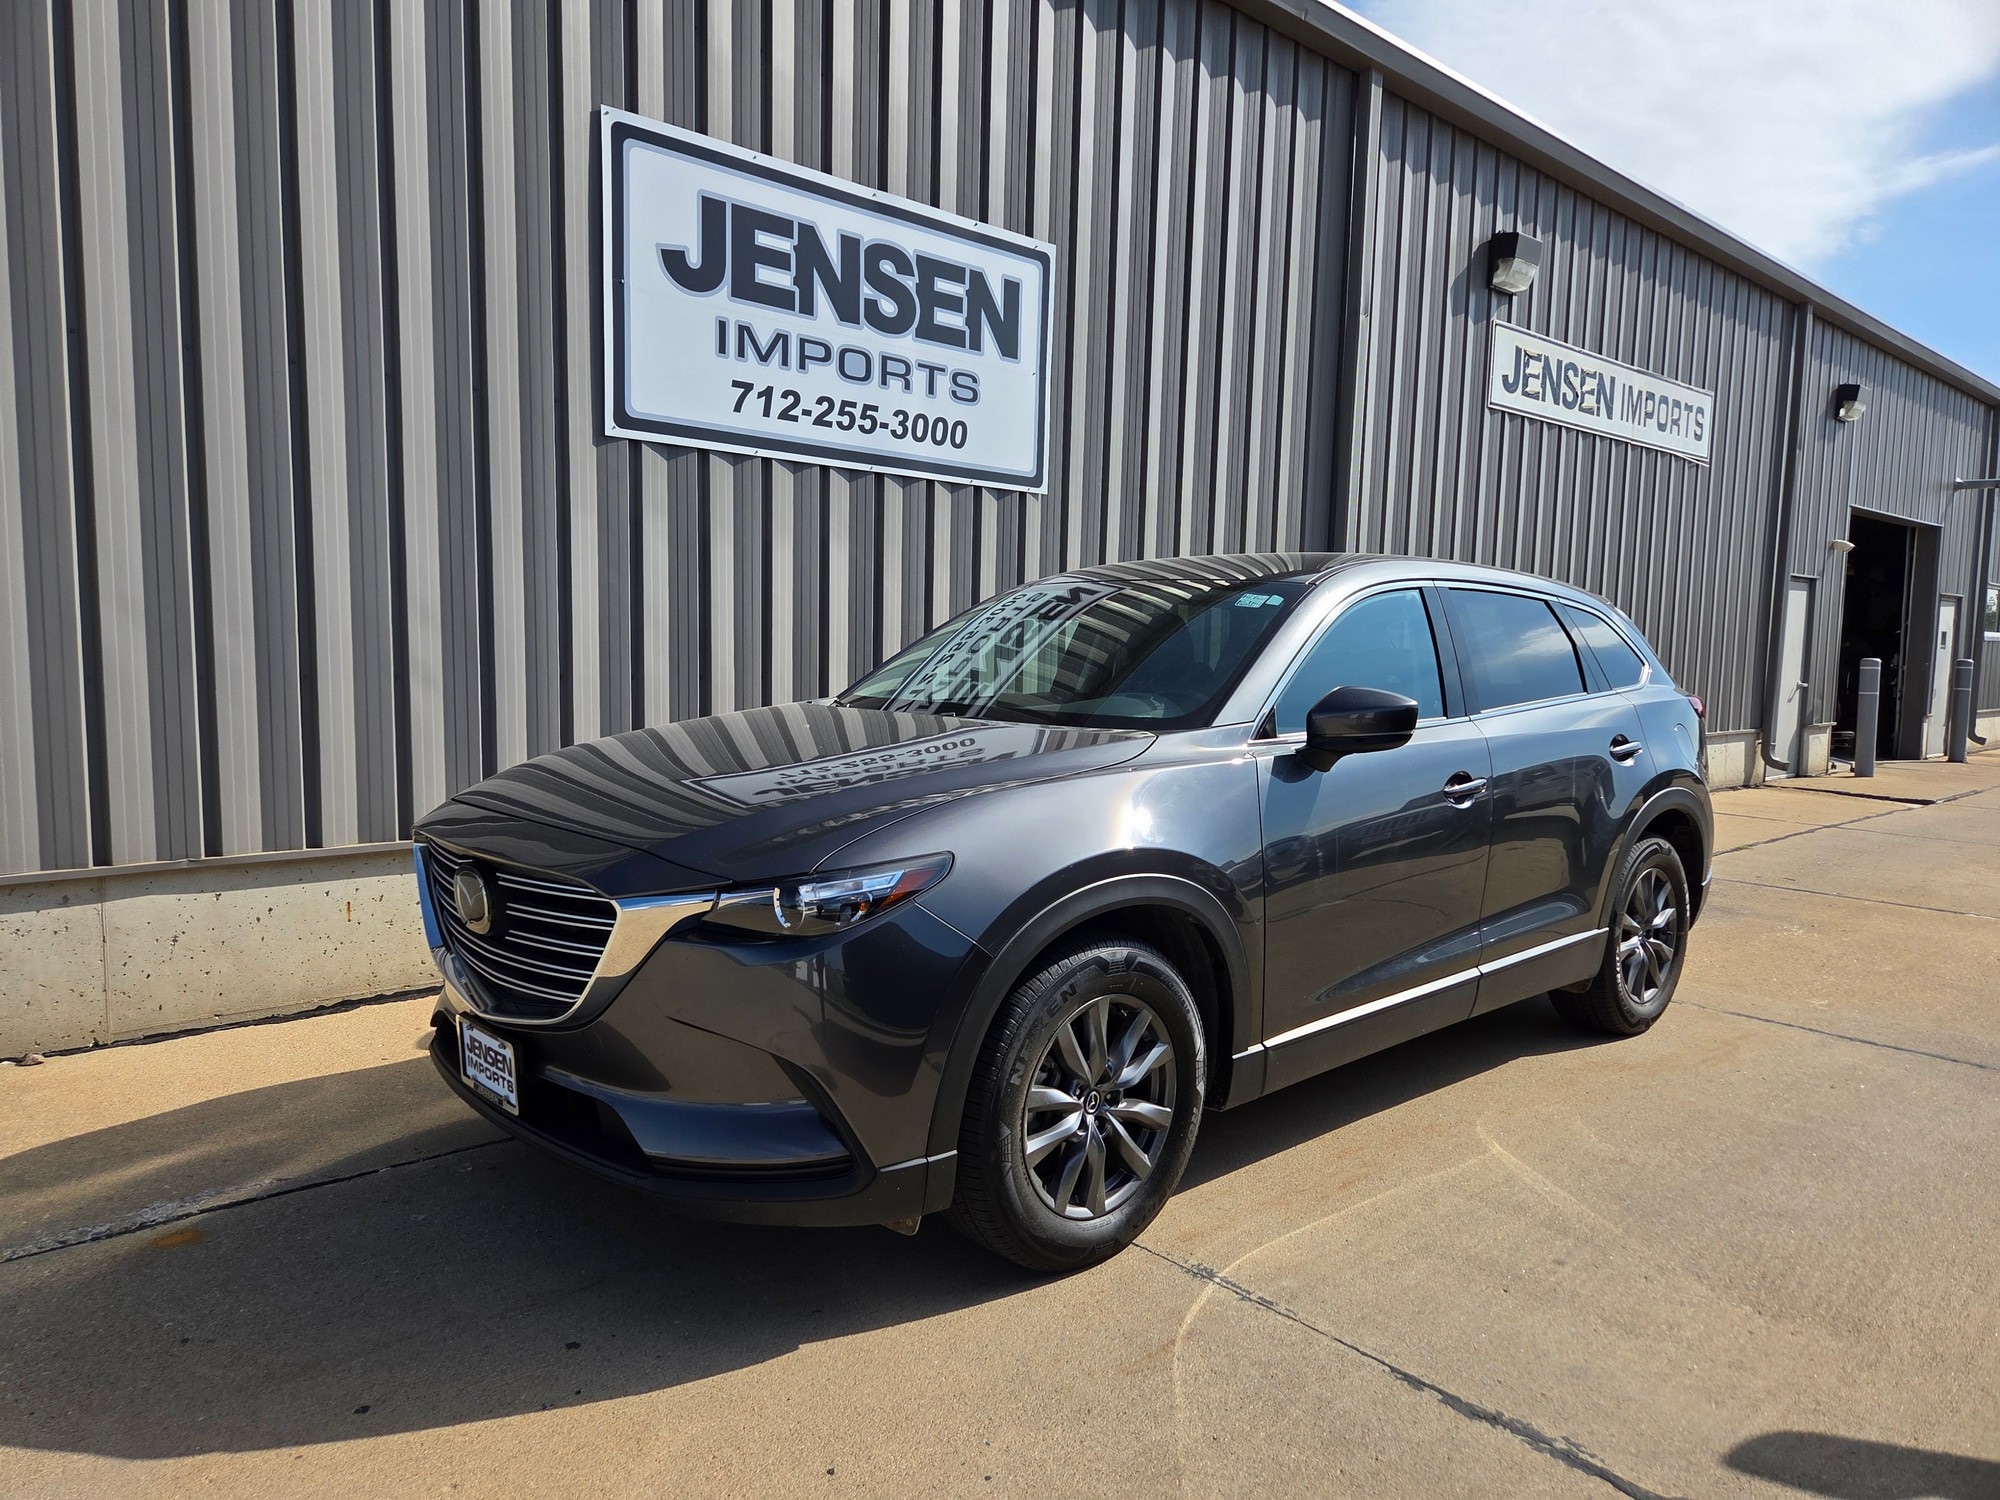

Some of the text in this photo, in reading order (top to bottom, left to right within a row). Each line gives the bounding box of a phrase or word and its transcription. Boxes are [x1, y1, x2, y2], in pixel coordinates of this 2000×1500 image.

[658, 192, 1022, 362] JENSEN
[716, 318, 980, 404] IMPORTS
[1501, 344, 1705, 443] JENSEN IMPORTS
[729, 379, 969, 450] 712-255-3000
[466, 1034, 514, 1079] JENSEN
[467, 1054, 514, 1094] IMPORTS
